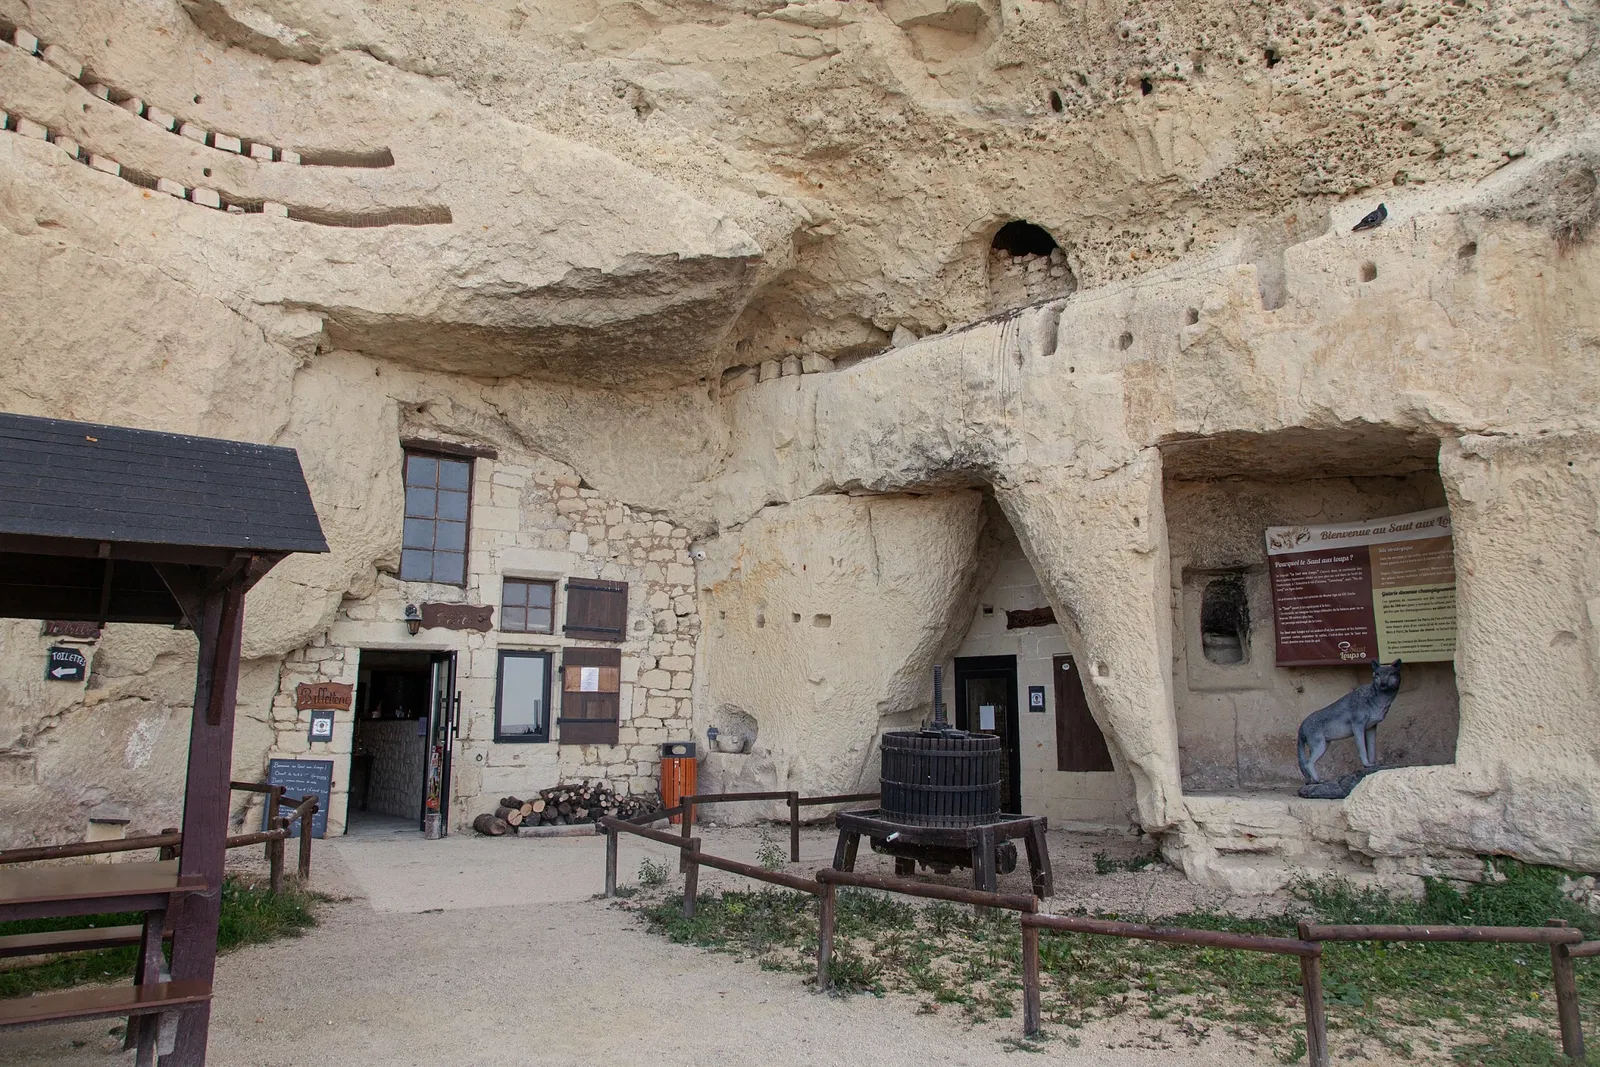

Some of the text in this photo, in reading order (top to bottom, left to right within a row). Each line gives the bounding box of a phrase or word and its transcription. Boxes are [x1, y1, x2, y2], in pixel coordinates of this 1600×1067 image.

[1320, 528, 1371, 541] Bienvenue
[1372, 526, 1386, 535] au
[1389, 521, 1413, 533] Saut
[1415, 519, 1435, 529] aux
[1274, 559, 1300, 569] Pourquoi
[1306, 557, 1321, 566] Saut
[1321, 556, 1333, 564] aux
[52, 652, 86, 667] TOILETTES
[1340, 651, 1360, 661] Loups
